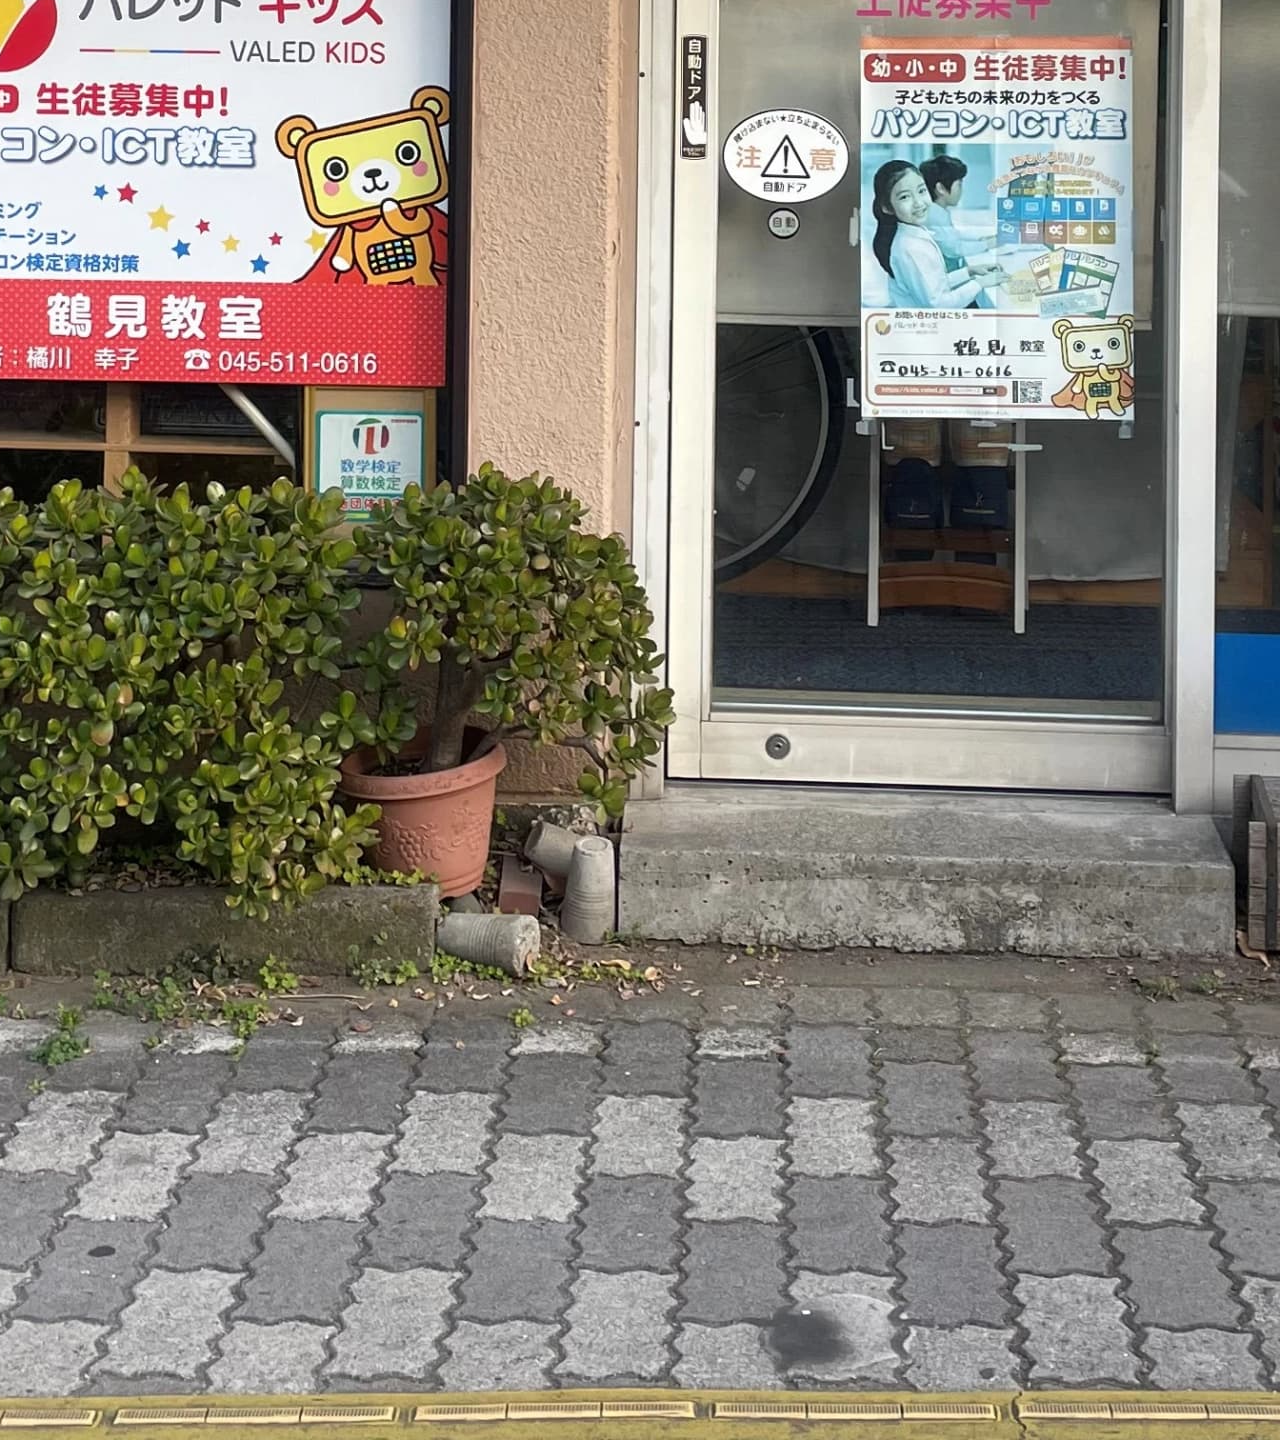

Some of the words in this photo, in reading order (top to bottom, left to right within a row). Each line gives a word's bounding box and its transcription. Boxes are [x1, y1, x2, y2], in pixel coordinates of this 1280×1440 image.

[231, 40, 315, 64] VALED
[325, 40, 386, 64] KIDS
[687, 38, 702, 100] 自動ドア
[895, 90, 1101, 106] 子どもたちの未来の力をつくる
[871, 107, 1127, 140] パソコン・ICT教室
[763, 181, 808, 194] 自動ドア
[772, 216, 796, 228] 自動
[47, 292, 264, 340] 鶴見教室
[1019, 339, 1045, 353] 教室
[94, 347, 140, 370] 幸子
[219, 350, 378, 374] 045-511-0616
[898, 364, 1013, 378] 045-511-0616
[340, 459, 402, 473] 数学検定
[340, 475, 402, 491] 算数検定
